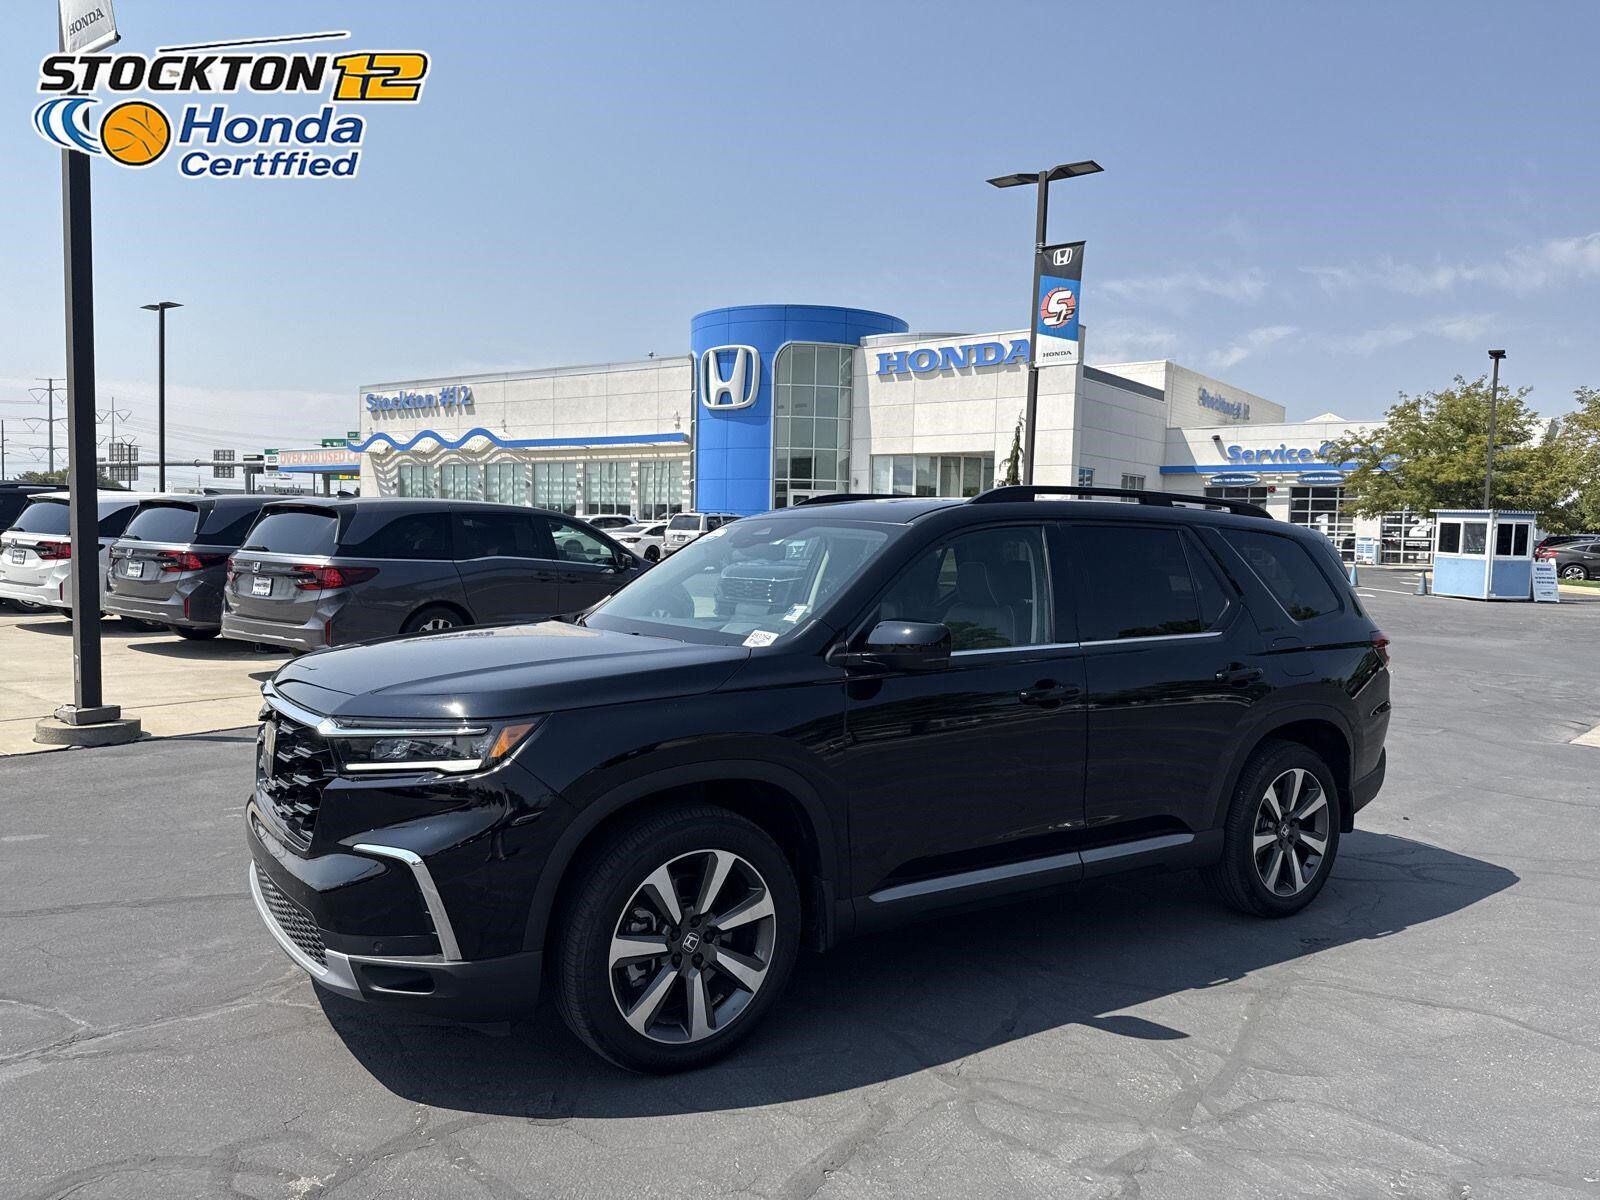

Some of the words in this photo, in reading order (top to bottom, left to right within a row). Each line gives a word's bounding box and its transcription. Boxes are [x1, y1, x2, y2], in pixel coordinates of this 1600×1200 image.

[69, 8, 105, 36] HONDA
[876, 339, 1030, 376] HONDA
[1042, 350, 1073, 358] HONDA
[366, 391, 436, 413] Stockton
[280, 452, 302, 465] OVER
[304, 451, 320, 464] 200
[322, 450, 345, 463] USED
[1227, 443, 1313, 464] Service
